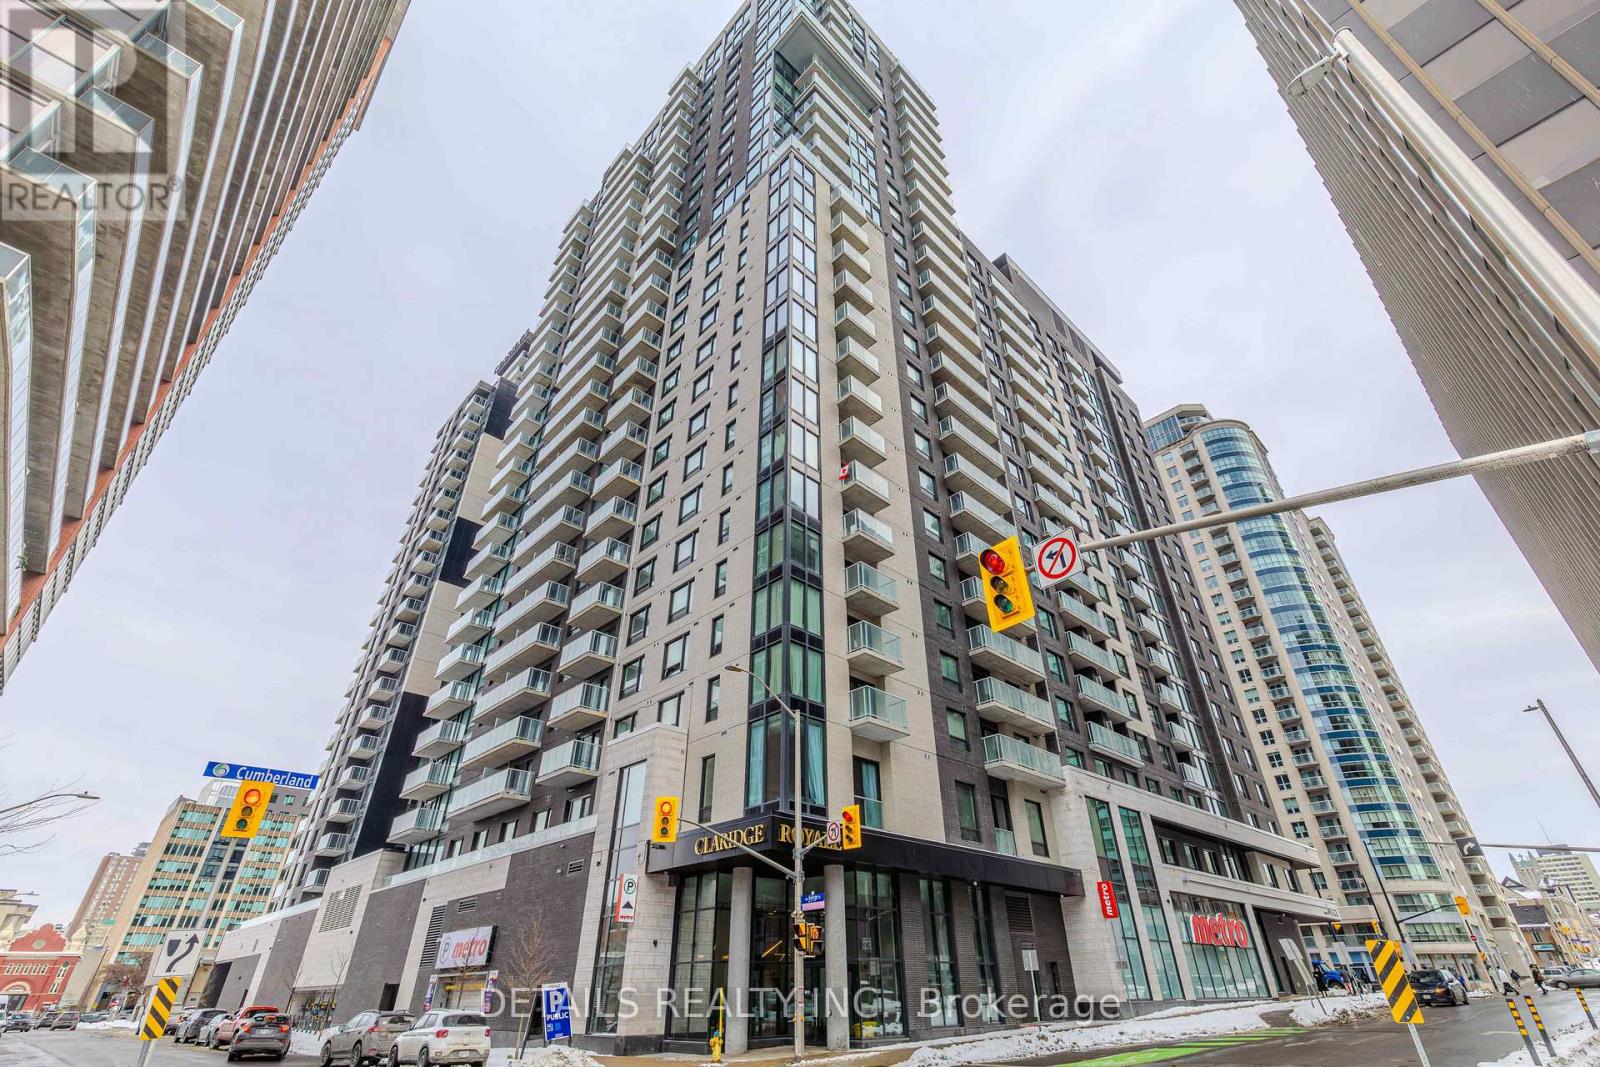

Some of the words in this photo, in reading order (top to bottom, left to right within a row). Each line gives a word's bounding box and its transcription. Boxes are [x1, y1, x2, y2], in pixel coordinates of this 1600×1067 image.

[236, 767, 313, 788] Cumberland
[694, 824, 764, 856] CLARIDGE
[626, 881, 634, 891] P
[1101, 883, 1114, 916] metro
[1191, 912, 1248, 948] metro
[452, 938, 487, 959] metro
[550, 991, 563, 1013] P
[546, 1011, 569, 1021] PUBLIC
